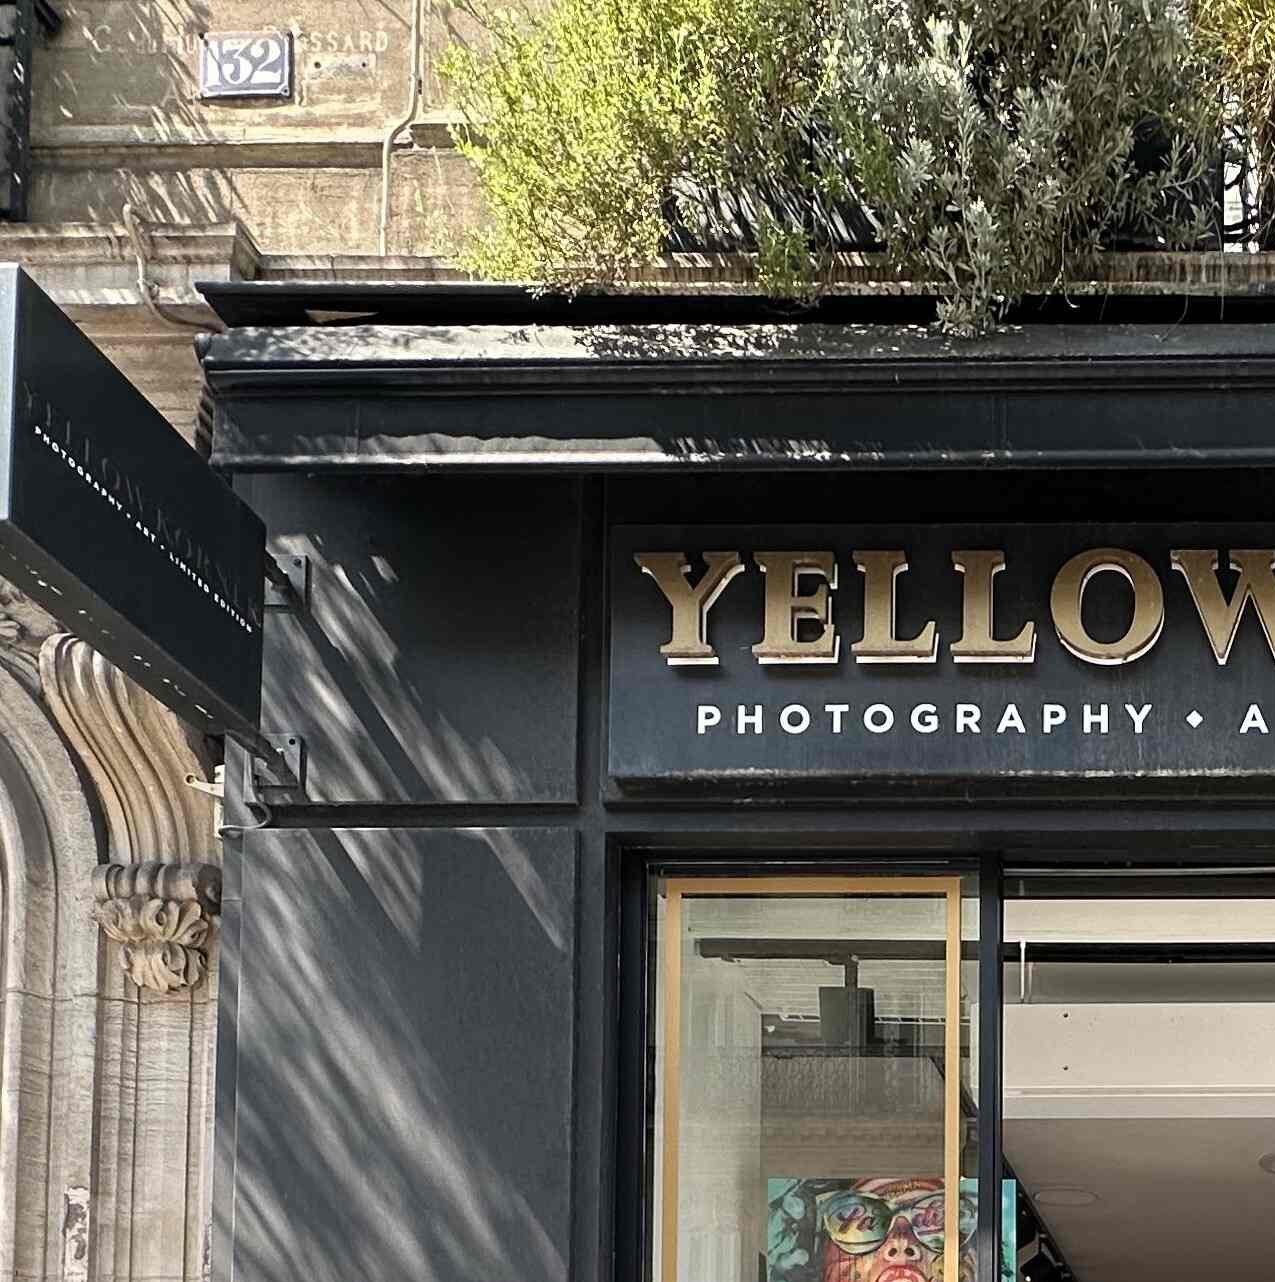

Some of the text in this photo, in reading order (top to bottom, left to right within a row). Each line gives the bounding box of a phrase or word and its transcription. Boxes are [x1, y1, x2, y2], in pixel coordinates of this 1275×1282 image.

[204, 37, 282, 88] 132
[34, 424, 123, 511] PHOTOGRAPHY
[135, 520, 157, 543] ART
[696, 703, 1154, 735] PHOTOGRAPHY
